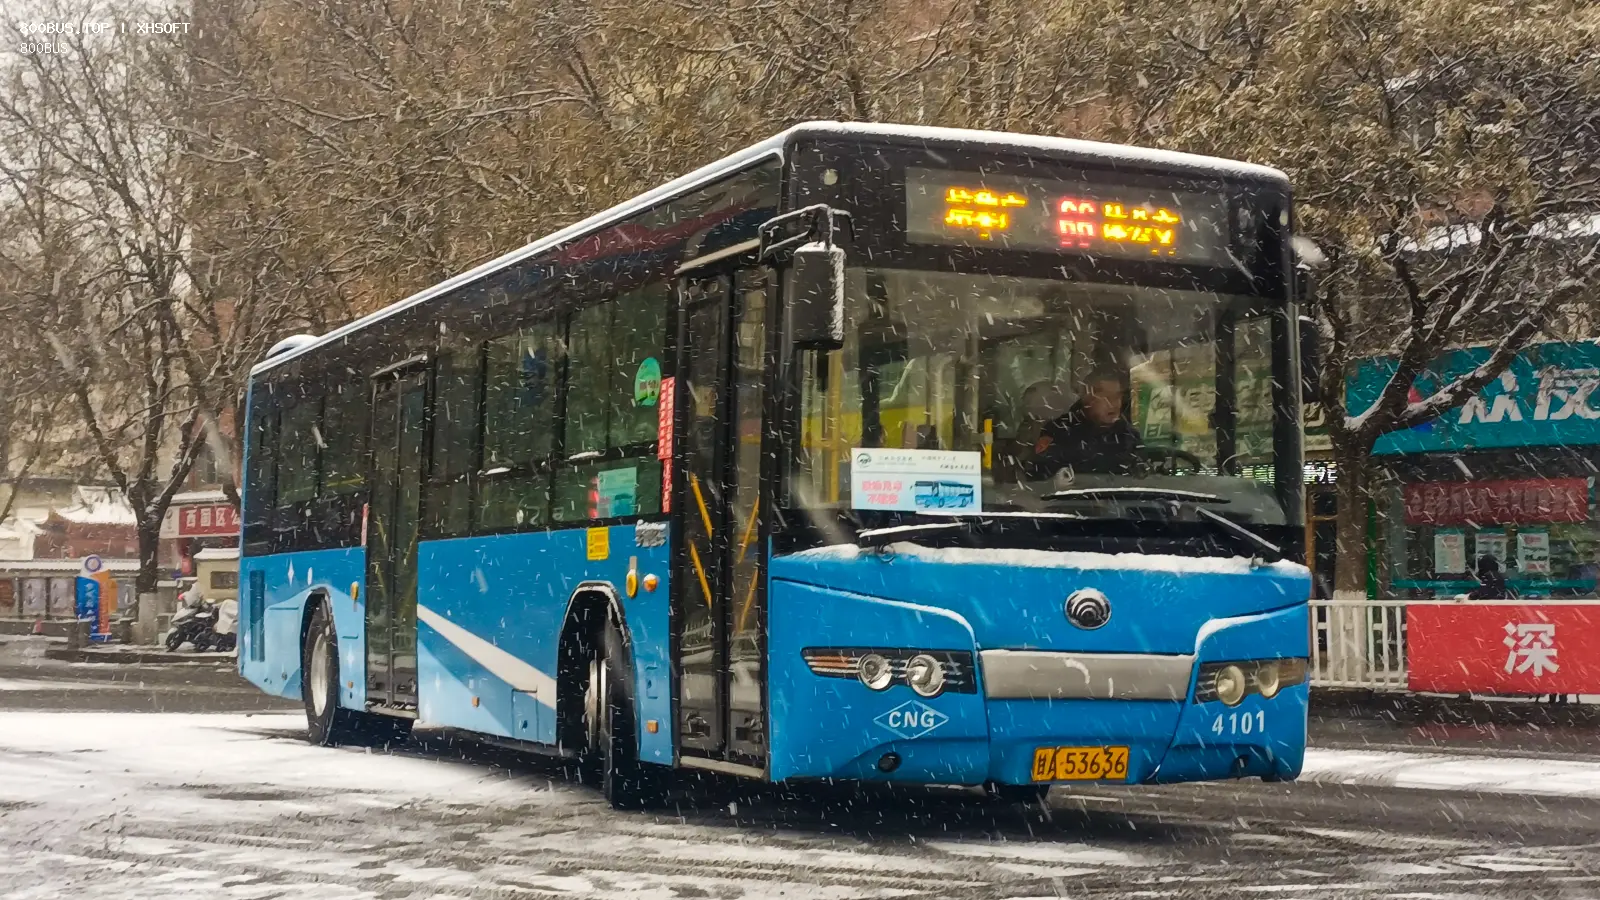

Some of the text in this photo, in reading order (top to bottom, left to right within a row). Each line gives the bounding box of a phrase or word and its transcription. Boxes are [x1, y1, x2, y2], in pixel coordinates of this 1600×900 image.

[1502, 621, 1560, 677] 深
[888, 711, 935, 729] CNG
[1211, 710, 1265, 736] 4101
